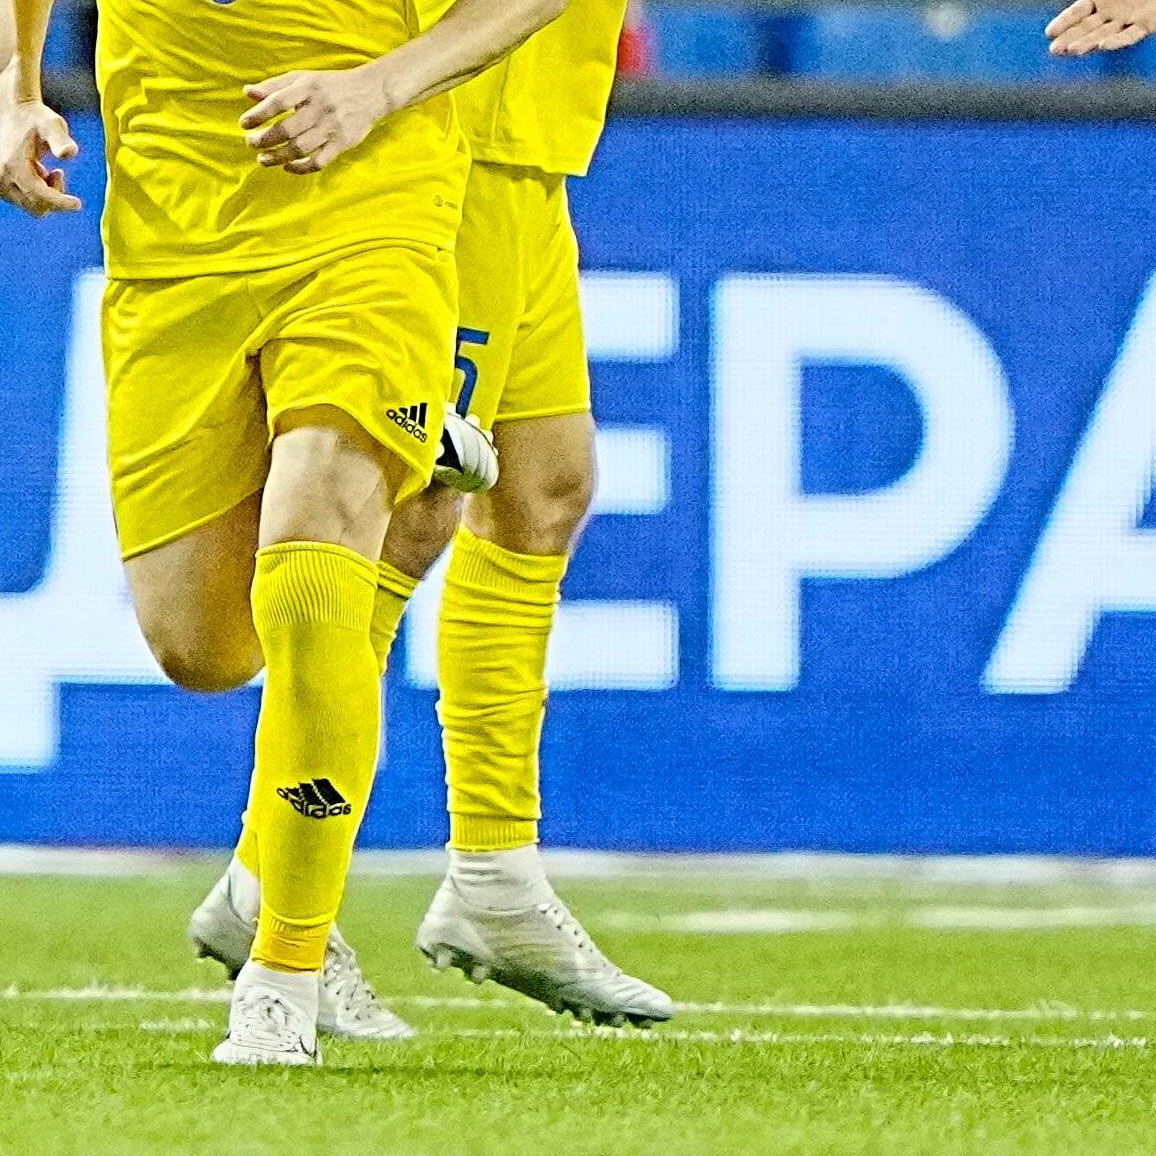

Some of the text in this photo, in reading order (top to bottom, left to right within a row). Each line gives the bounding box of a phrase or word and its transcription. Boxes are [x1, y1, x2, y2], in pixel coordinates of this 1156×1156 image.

[455, 326, 490, 419] 5
[385, 408, 428, 443] adidas
[277, 787, 352, 819] adidas
